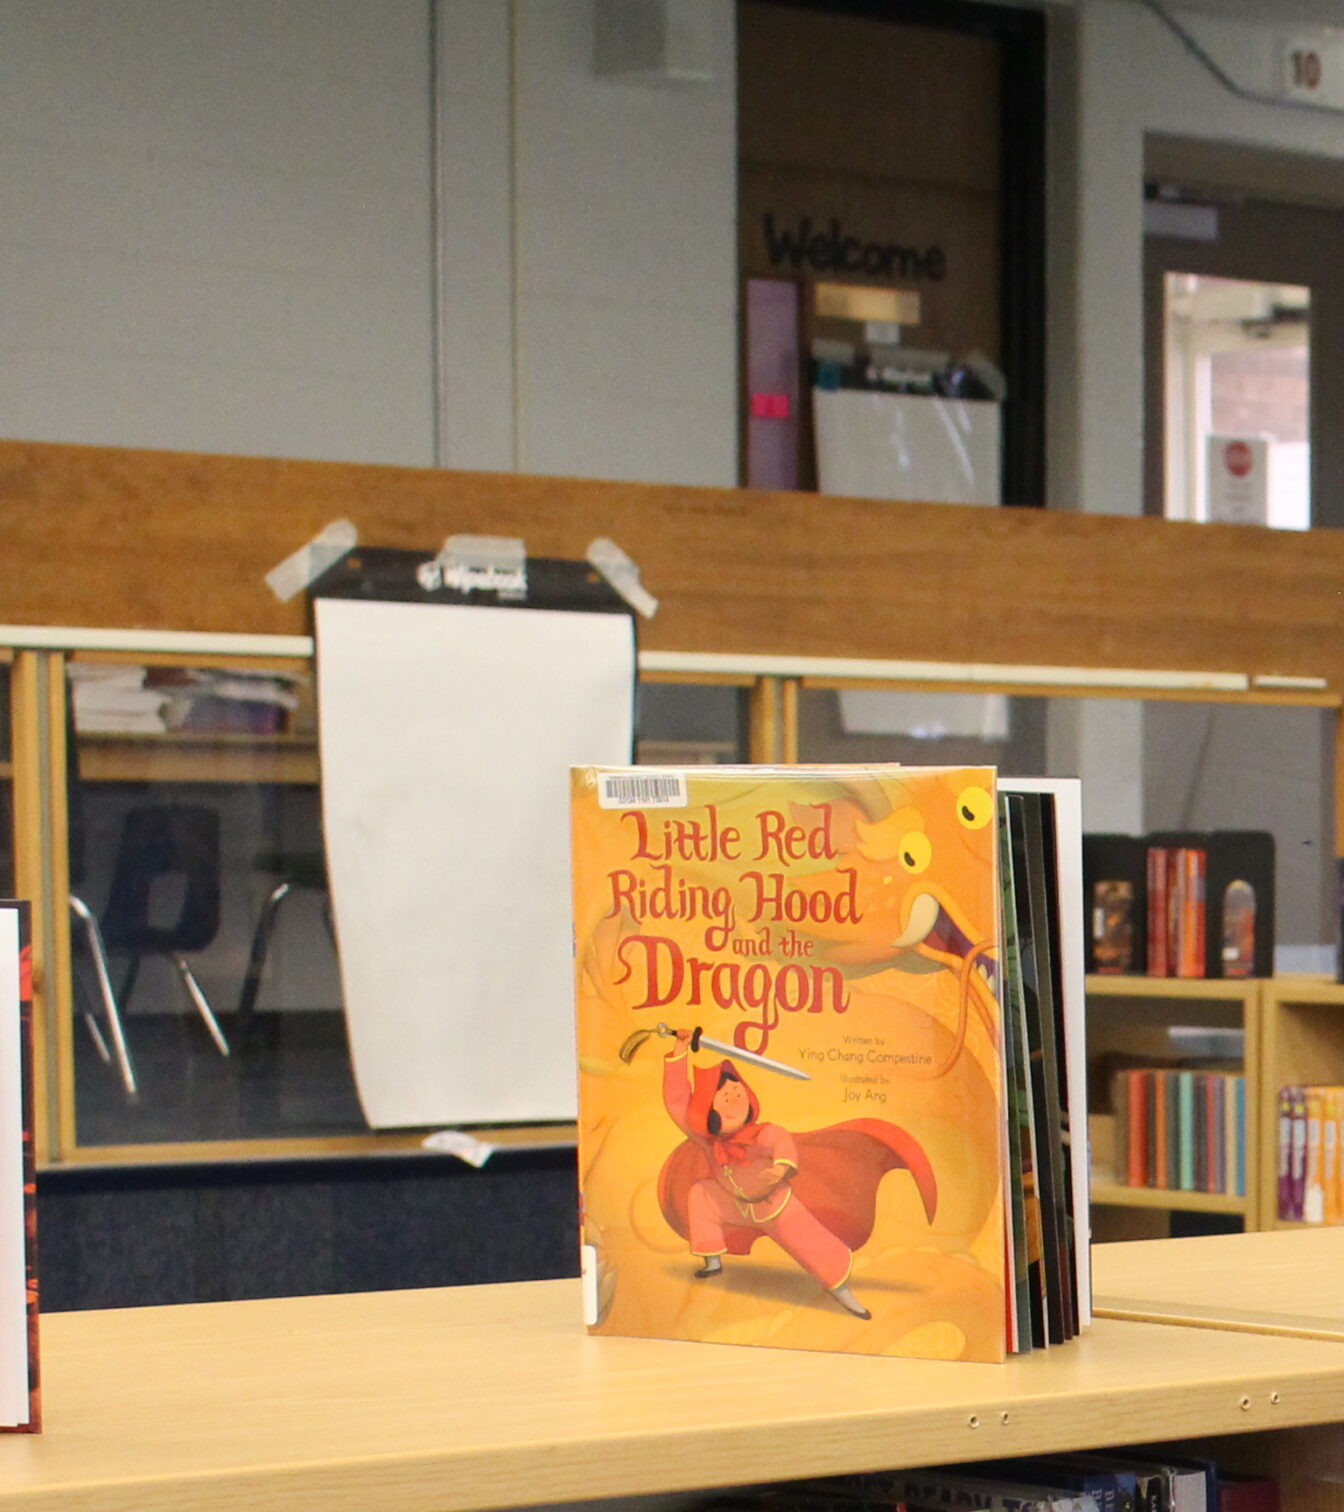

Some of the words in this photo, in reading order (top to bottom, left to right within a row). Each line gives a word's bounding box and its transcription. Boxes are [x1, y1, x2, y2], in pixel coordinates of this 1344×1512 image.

[1291, 49, 1322, 89] 10
[764, 212, 946, 280] Welcome
[621, 804, 741, 863] Little
[756, 804, 838, 863] Red
[606, 865, 736, 952] Riding
[738, 869, 864, 926] Hood
[733, 935, 773, 958] and
[779, 930, 814, 959] the
[613, 935, 850, 1056] Dragon
[799, 1048, 826, 1066] Ying
[828, 1048, 864, 1066] Chang
[866, 1049, 933, 1068] Compestine
[842, 1088, 860, 1105] Joy
[864, 1089, 887, 1105] Ang
